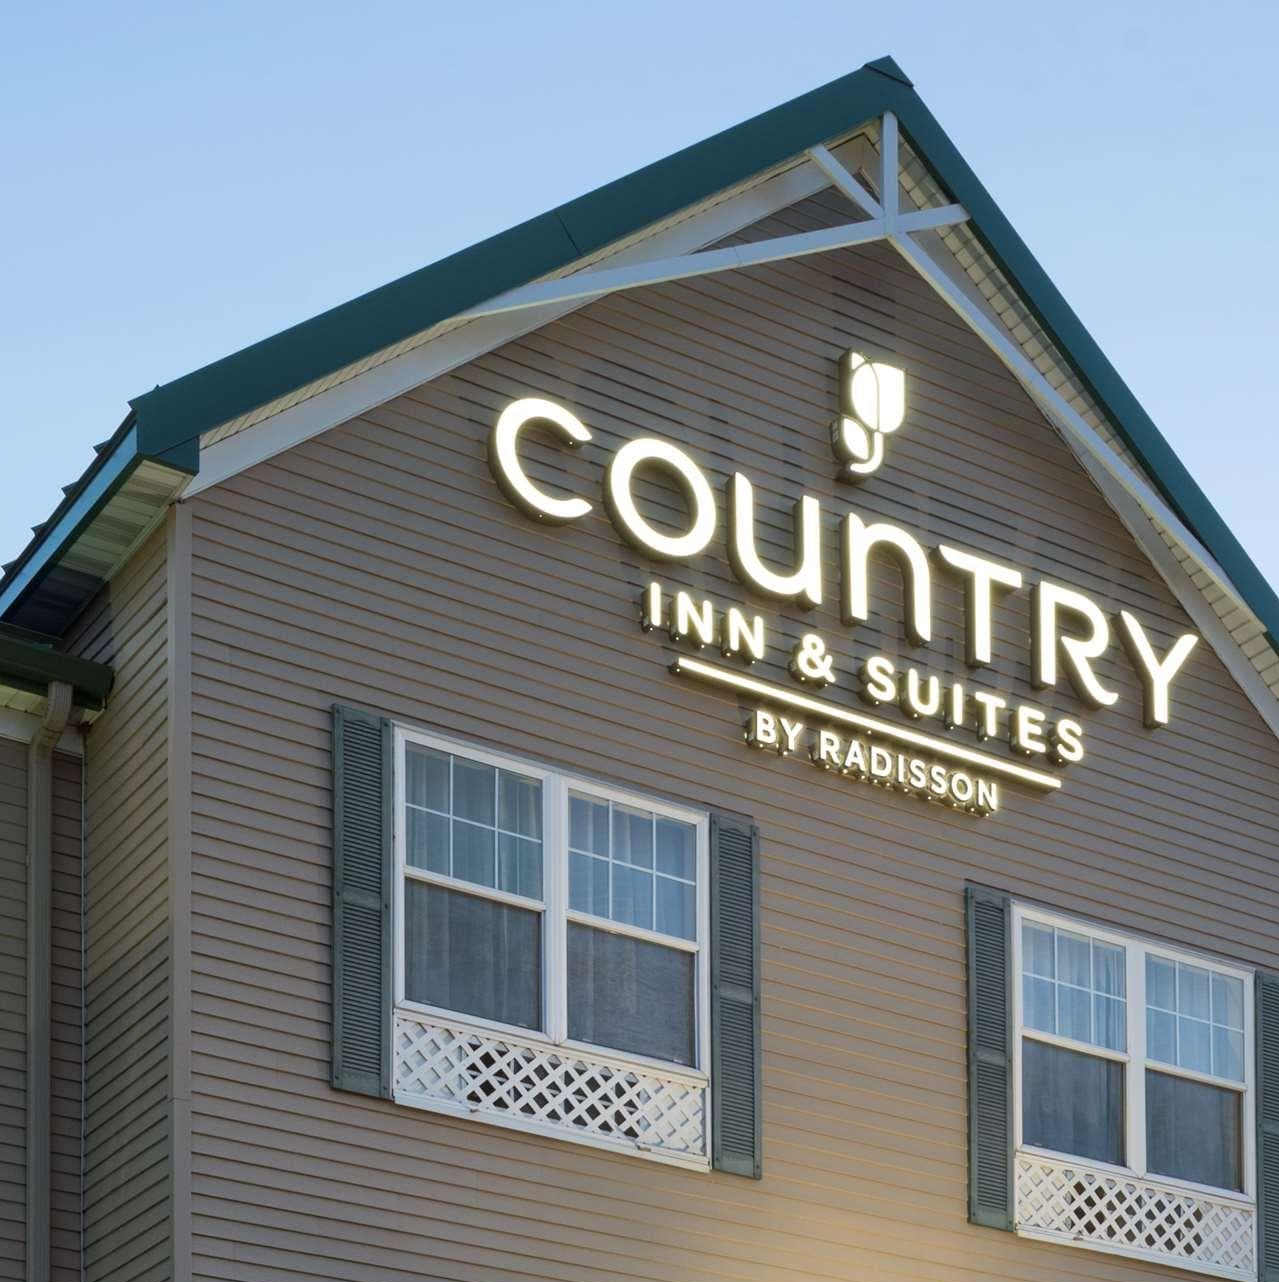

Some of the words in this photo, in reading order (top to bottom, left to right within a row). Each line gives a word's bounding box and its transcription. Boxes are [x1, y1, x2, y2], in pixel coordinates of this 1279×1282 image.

[649, 580, 766, 661] INN
[796, 632, 838, 684] &
[866, 654, 1086, 764] SUITES
[755, 709, 804, 752] BY
[819, 729, 1000, 812] RADISSON
